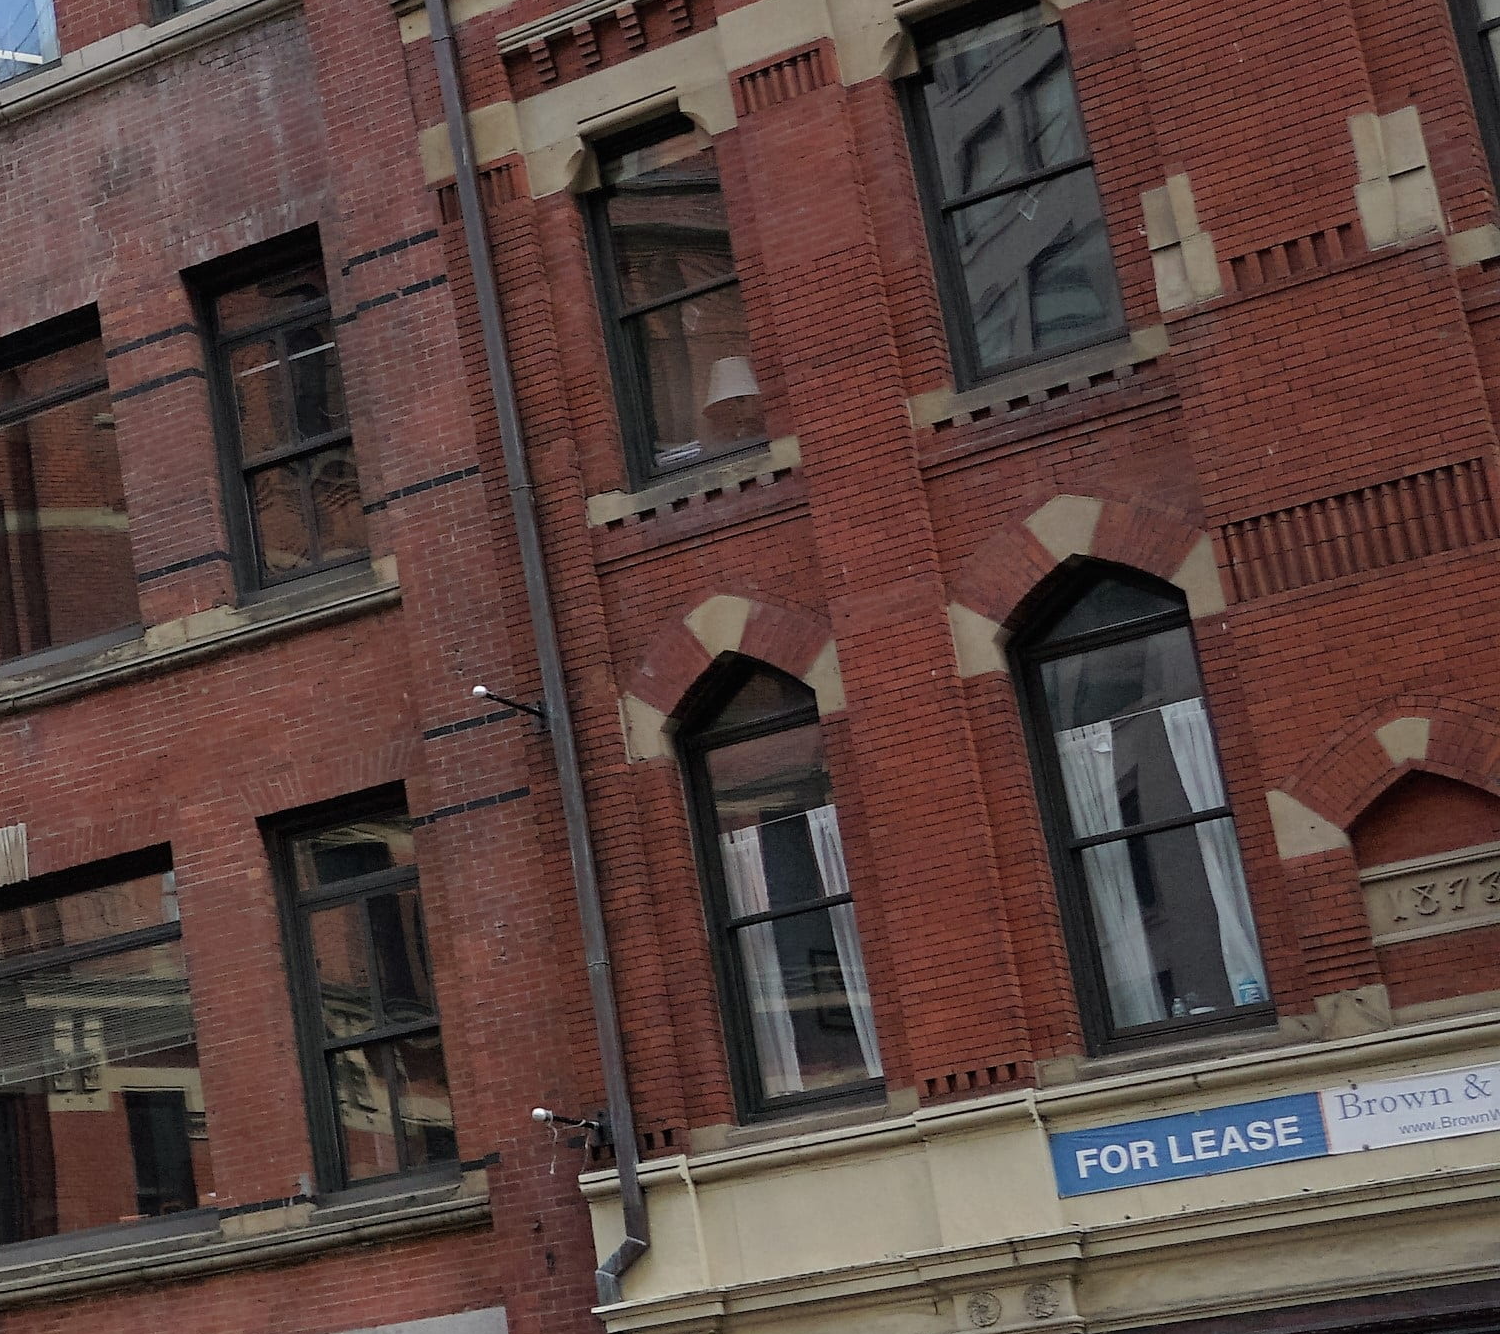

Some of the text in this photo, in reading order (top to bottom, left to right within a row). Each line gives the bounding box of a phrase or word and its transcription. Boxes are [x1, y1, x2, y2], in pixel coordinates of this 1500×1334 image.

[1337, 1073, 1492, 1121] Brown &
[1075, 1115, 1304, 1179] FOR LEASE
